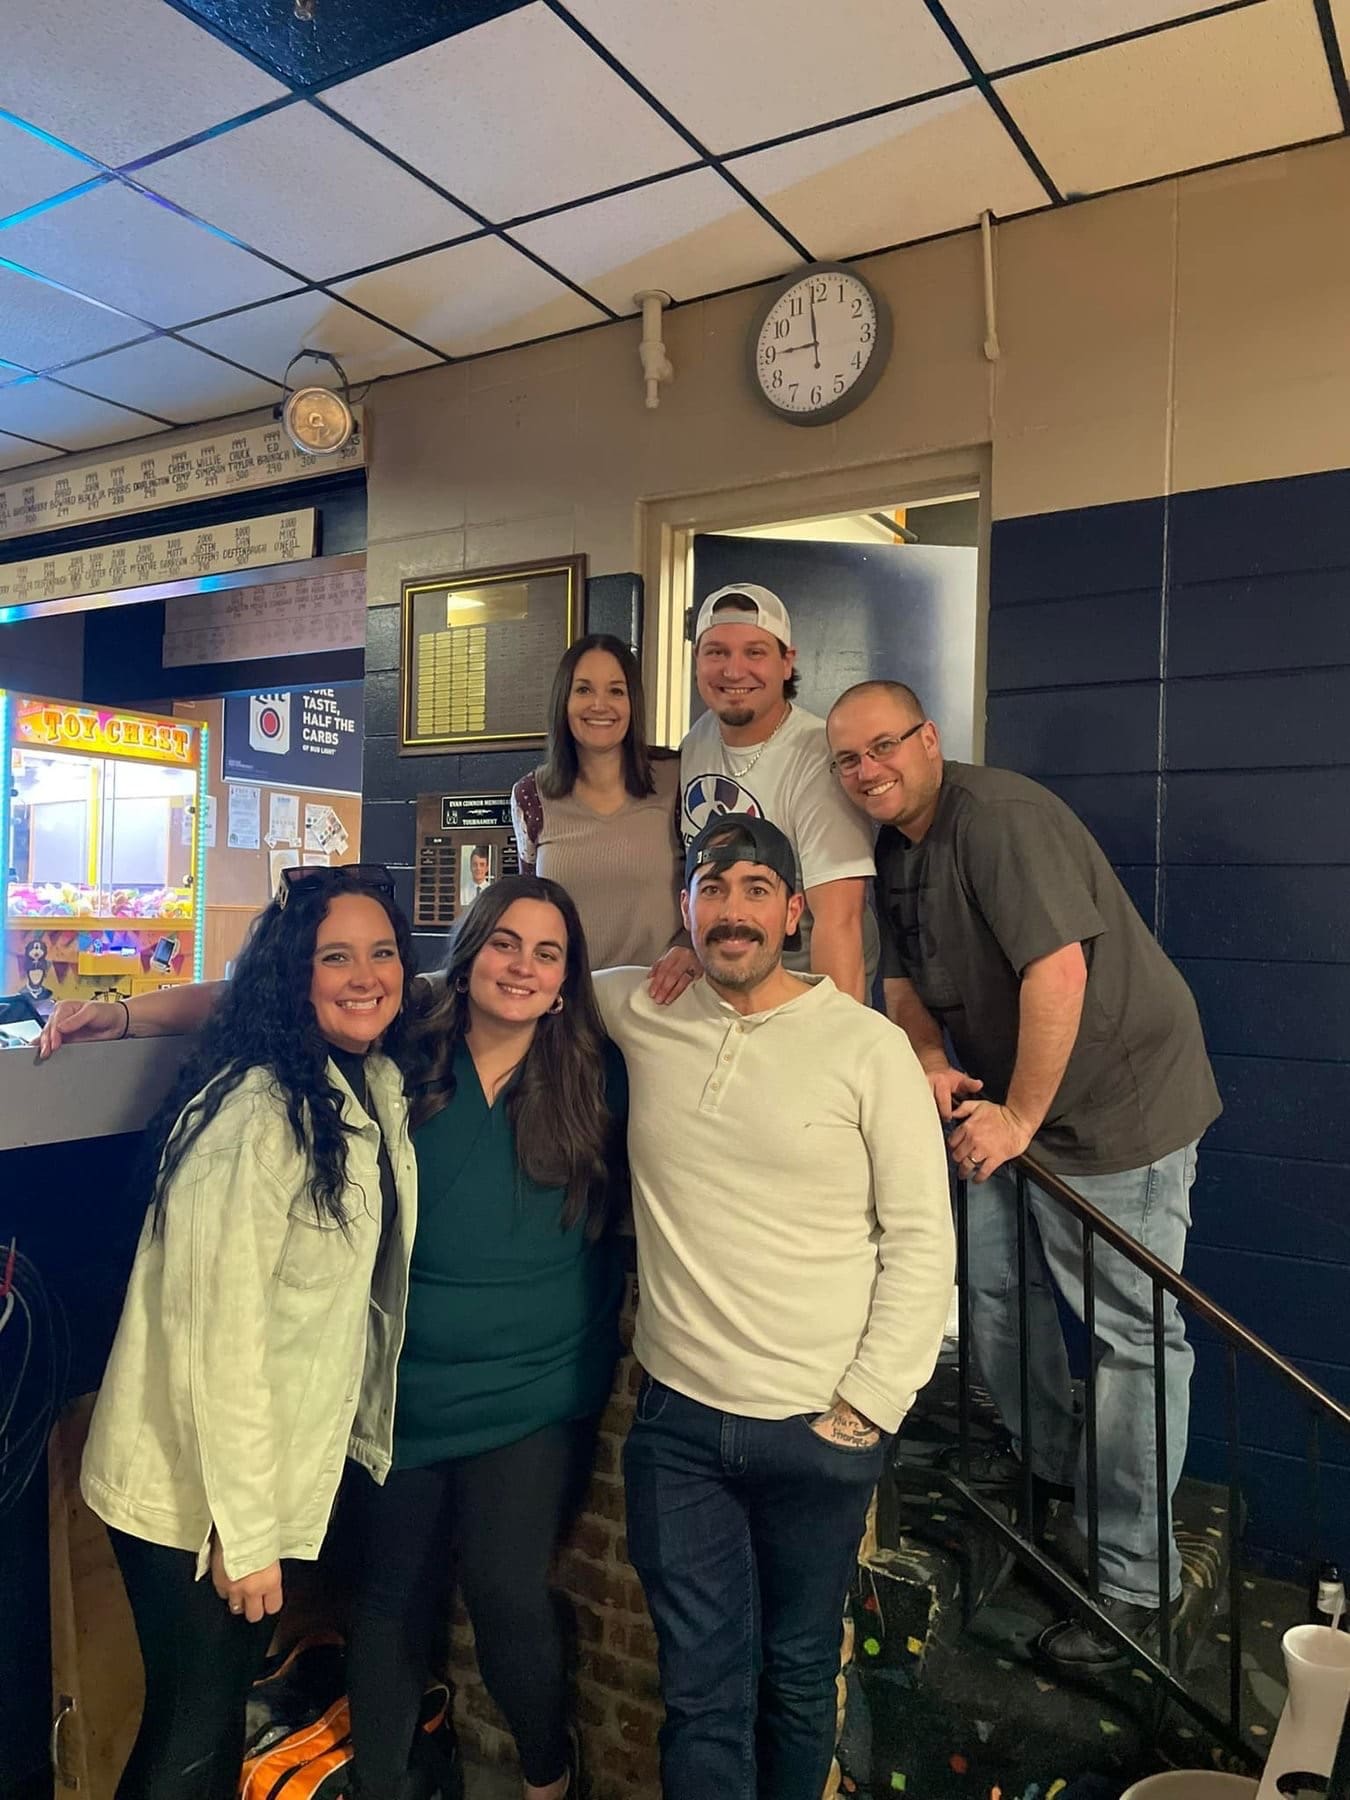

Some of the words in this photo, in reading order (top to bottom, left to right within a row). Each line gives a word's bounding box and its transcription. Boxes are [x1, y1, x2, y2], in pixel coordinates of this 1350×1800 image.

[810, 283, 827, 304] 12
[838, 284, 844, 303] 1
[790, 297, 802, 317] 11
[851, 298, 862, 319] 2
[774, 318, 790, 340] 10
[860, 323, 871, 343] 3
[765, 345, 776, 365] 9
[851, 351, 861, 370] 4
[772, 369, 783, 389] 8
[833, 374, 844, 394] 5
[788, 383, 799, 402] 7
[810, 385, 822, 405] 6
[229, 448, 251, 462] CHUCK
[266, 442, 279, 453] ED
[168, 461, 194, 475] CHERYL
[196, 454, 222, 467] WILLIE
[228, 457, 255, 472] TAYLOR
[172, 470, 191, 484] CAMP
[167, 547, 184, 558] MATT
[302, 695, 340, 716] TASTE,
[302, 711, 332, 728] HALF
[334, 717, 355, 733] THE
[43, 710, 98, 741] TOY
[105, 720, 189, 758] CHEST
[302, 728, 339, 745] CARBS
[449, 800, 462, 808] EVAN
[462, 818, 498, 826] TOURNAMENT
